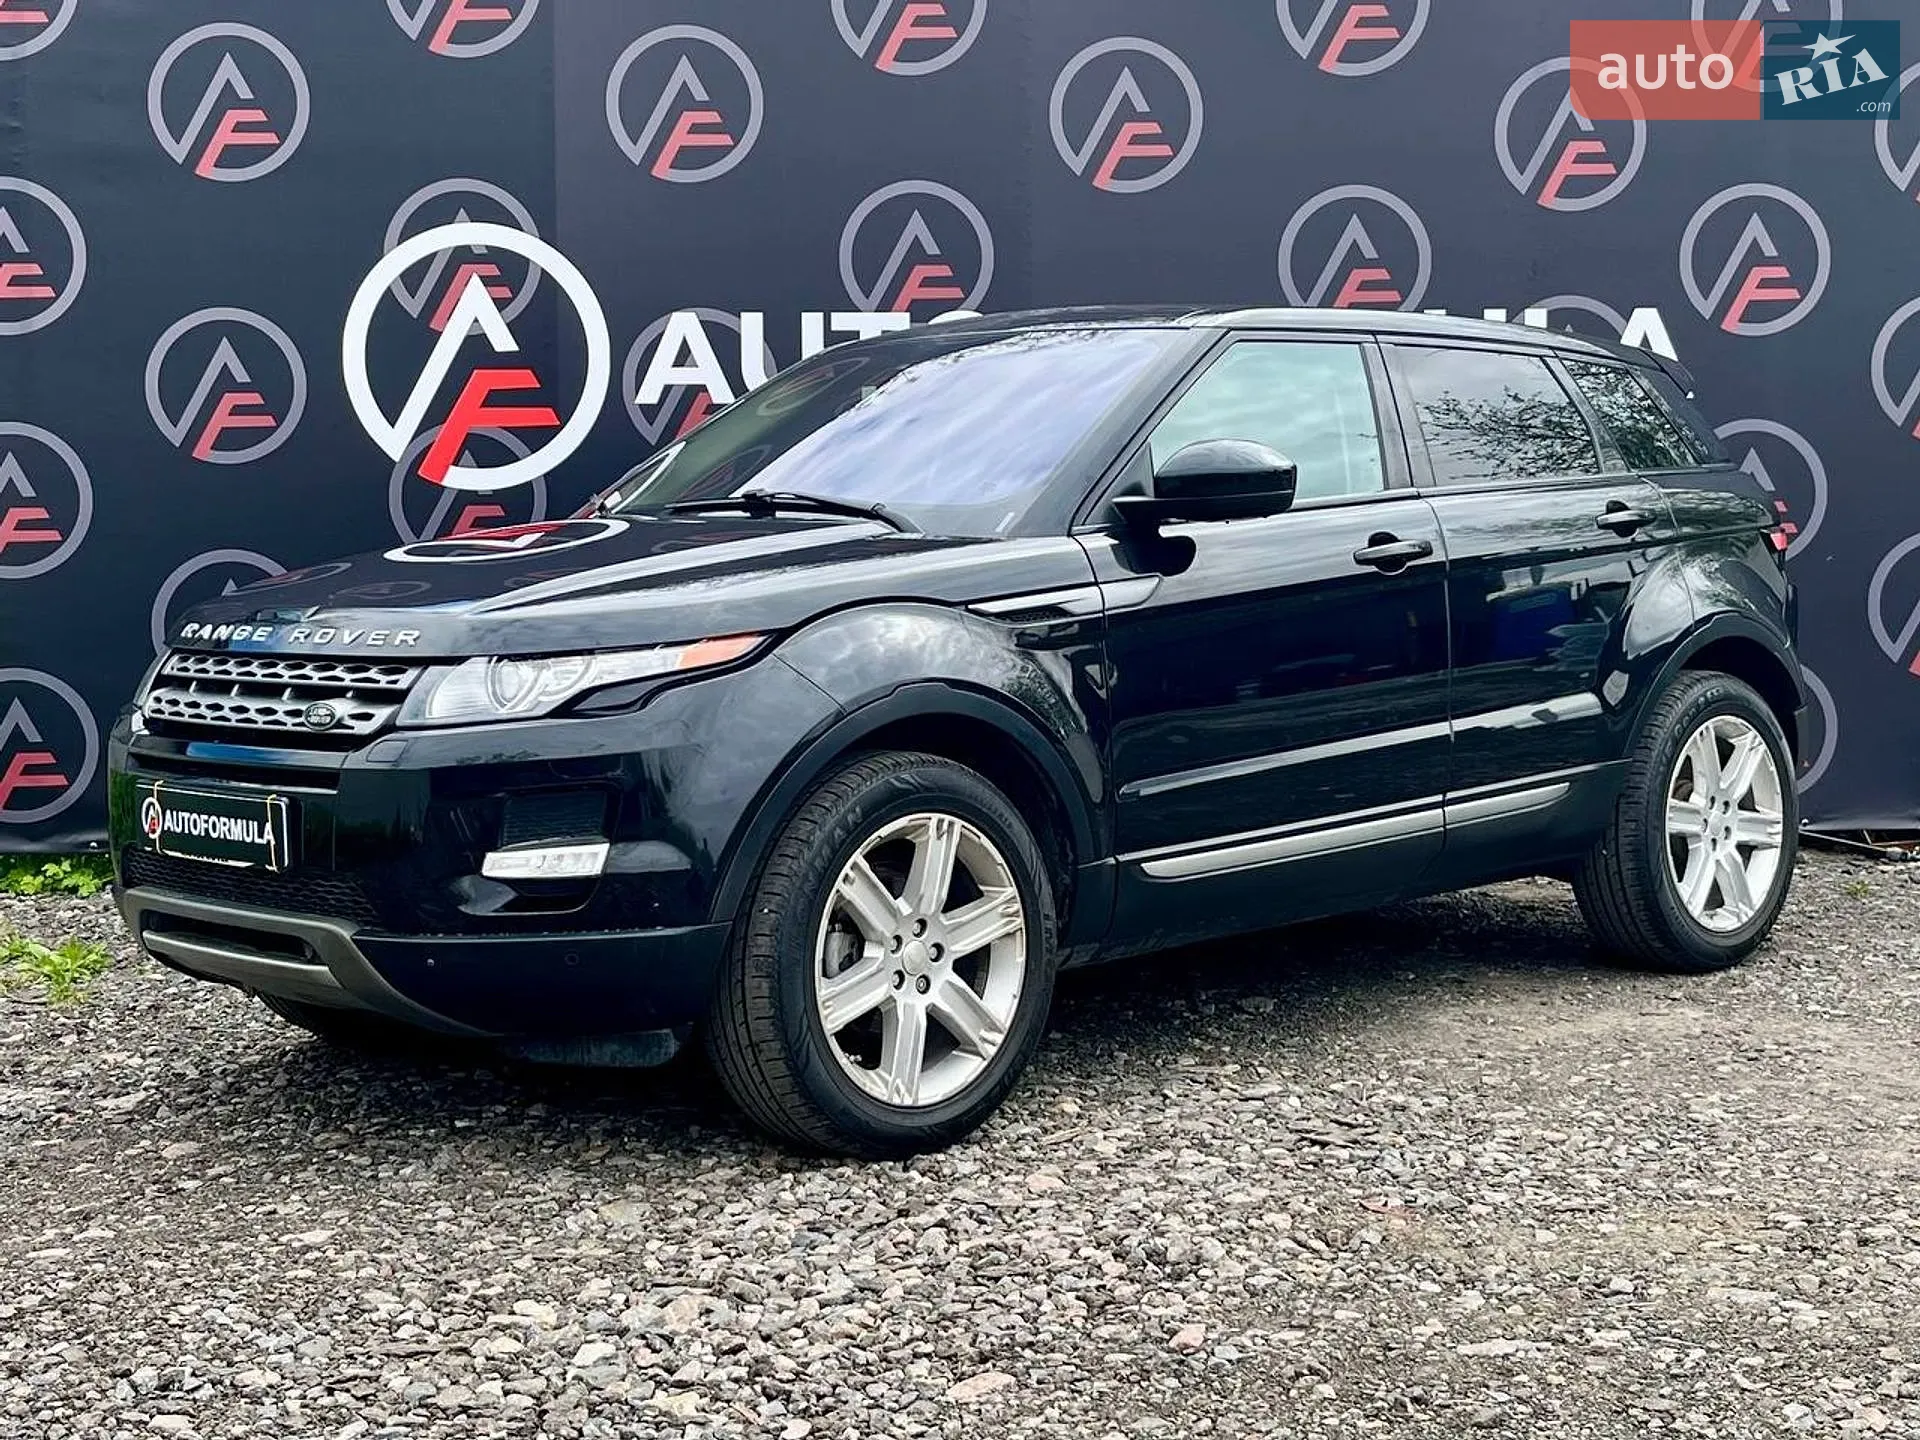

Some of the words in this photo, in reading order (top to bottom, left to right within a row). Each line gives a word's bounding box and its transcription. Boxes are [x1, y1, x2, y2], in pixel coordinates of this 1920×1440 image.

[180, 622, 273, 642] RANGE
[288, 628, 421, 647] ROVER
[164, 808, 275, 846] AUTOFORMULA
